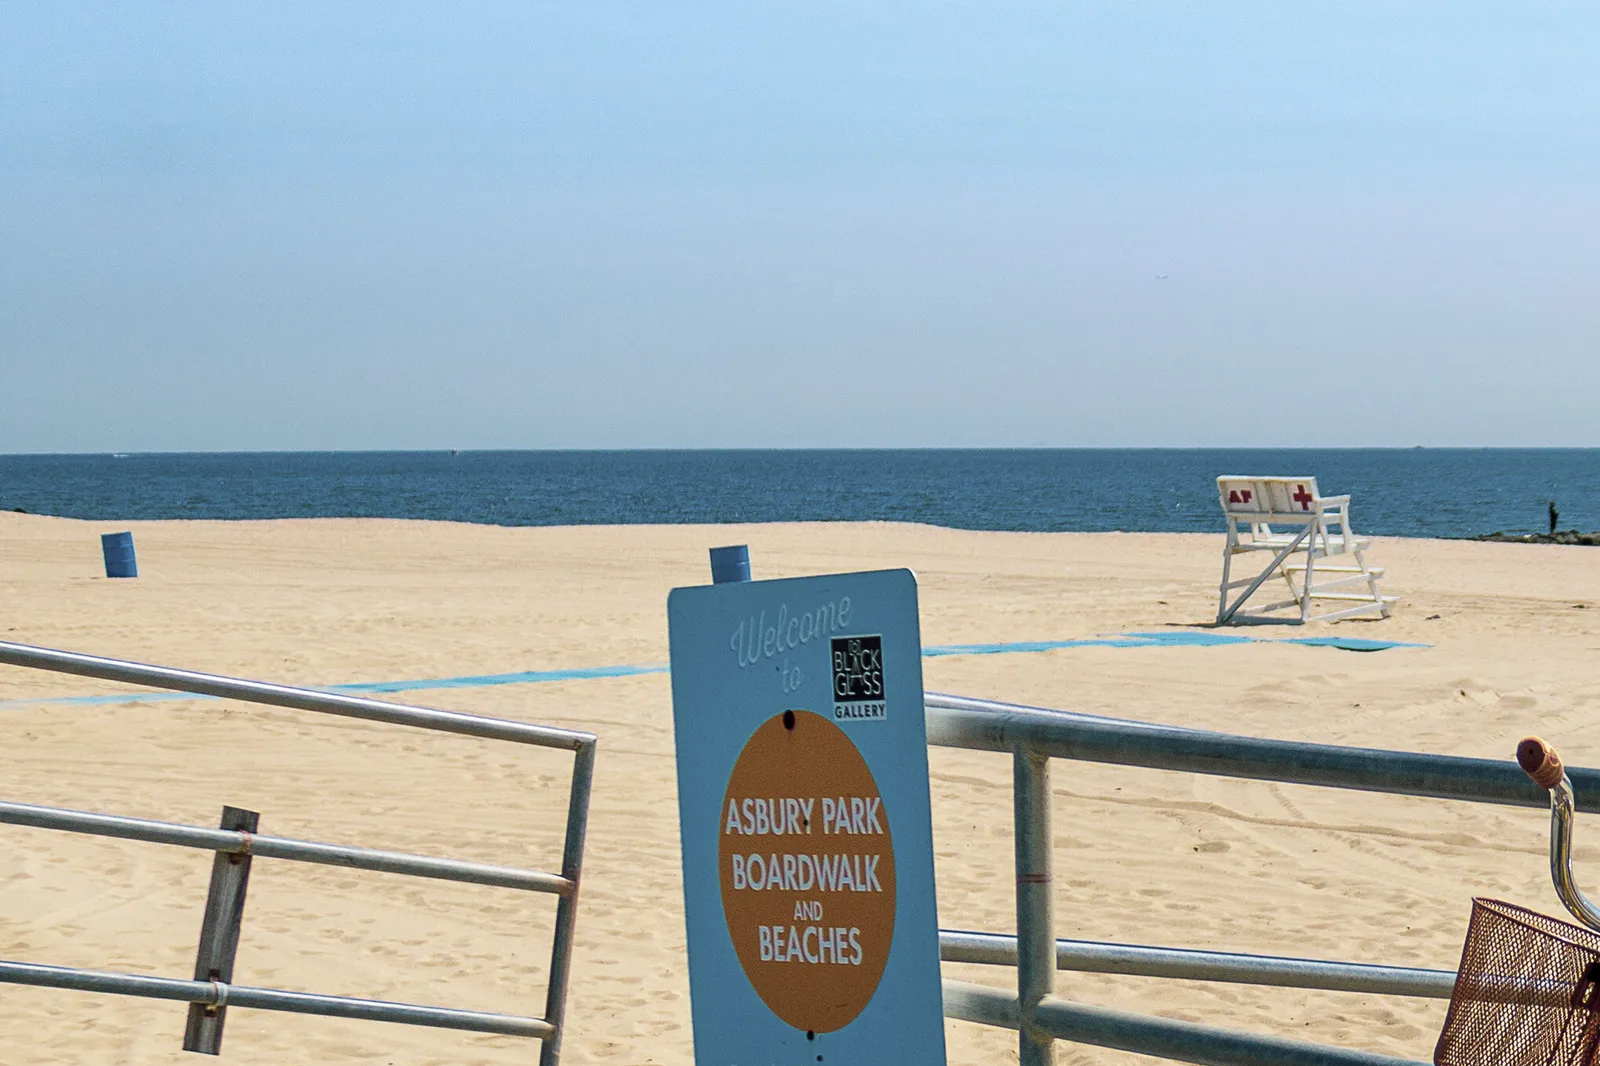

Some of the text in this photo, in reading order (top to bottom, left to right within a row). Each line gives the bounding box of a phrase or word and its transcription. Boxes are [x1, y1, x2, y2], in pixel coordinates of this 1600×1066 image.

[730, 594, 852, 668] Welcome
[782, 662, 802, 695] to
[834, 704, 885, 719] GALLERY
[725, 797, 884, 835] ASBURY PARK
[732, 854, 882, 892] BOARDWALK
[794, 901, 823, 922] AND
[758, 926, 863, 965] BEACHES
